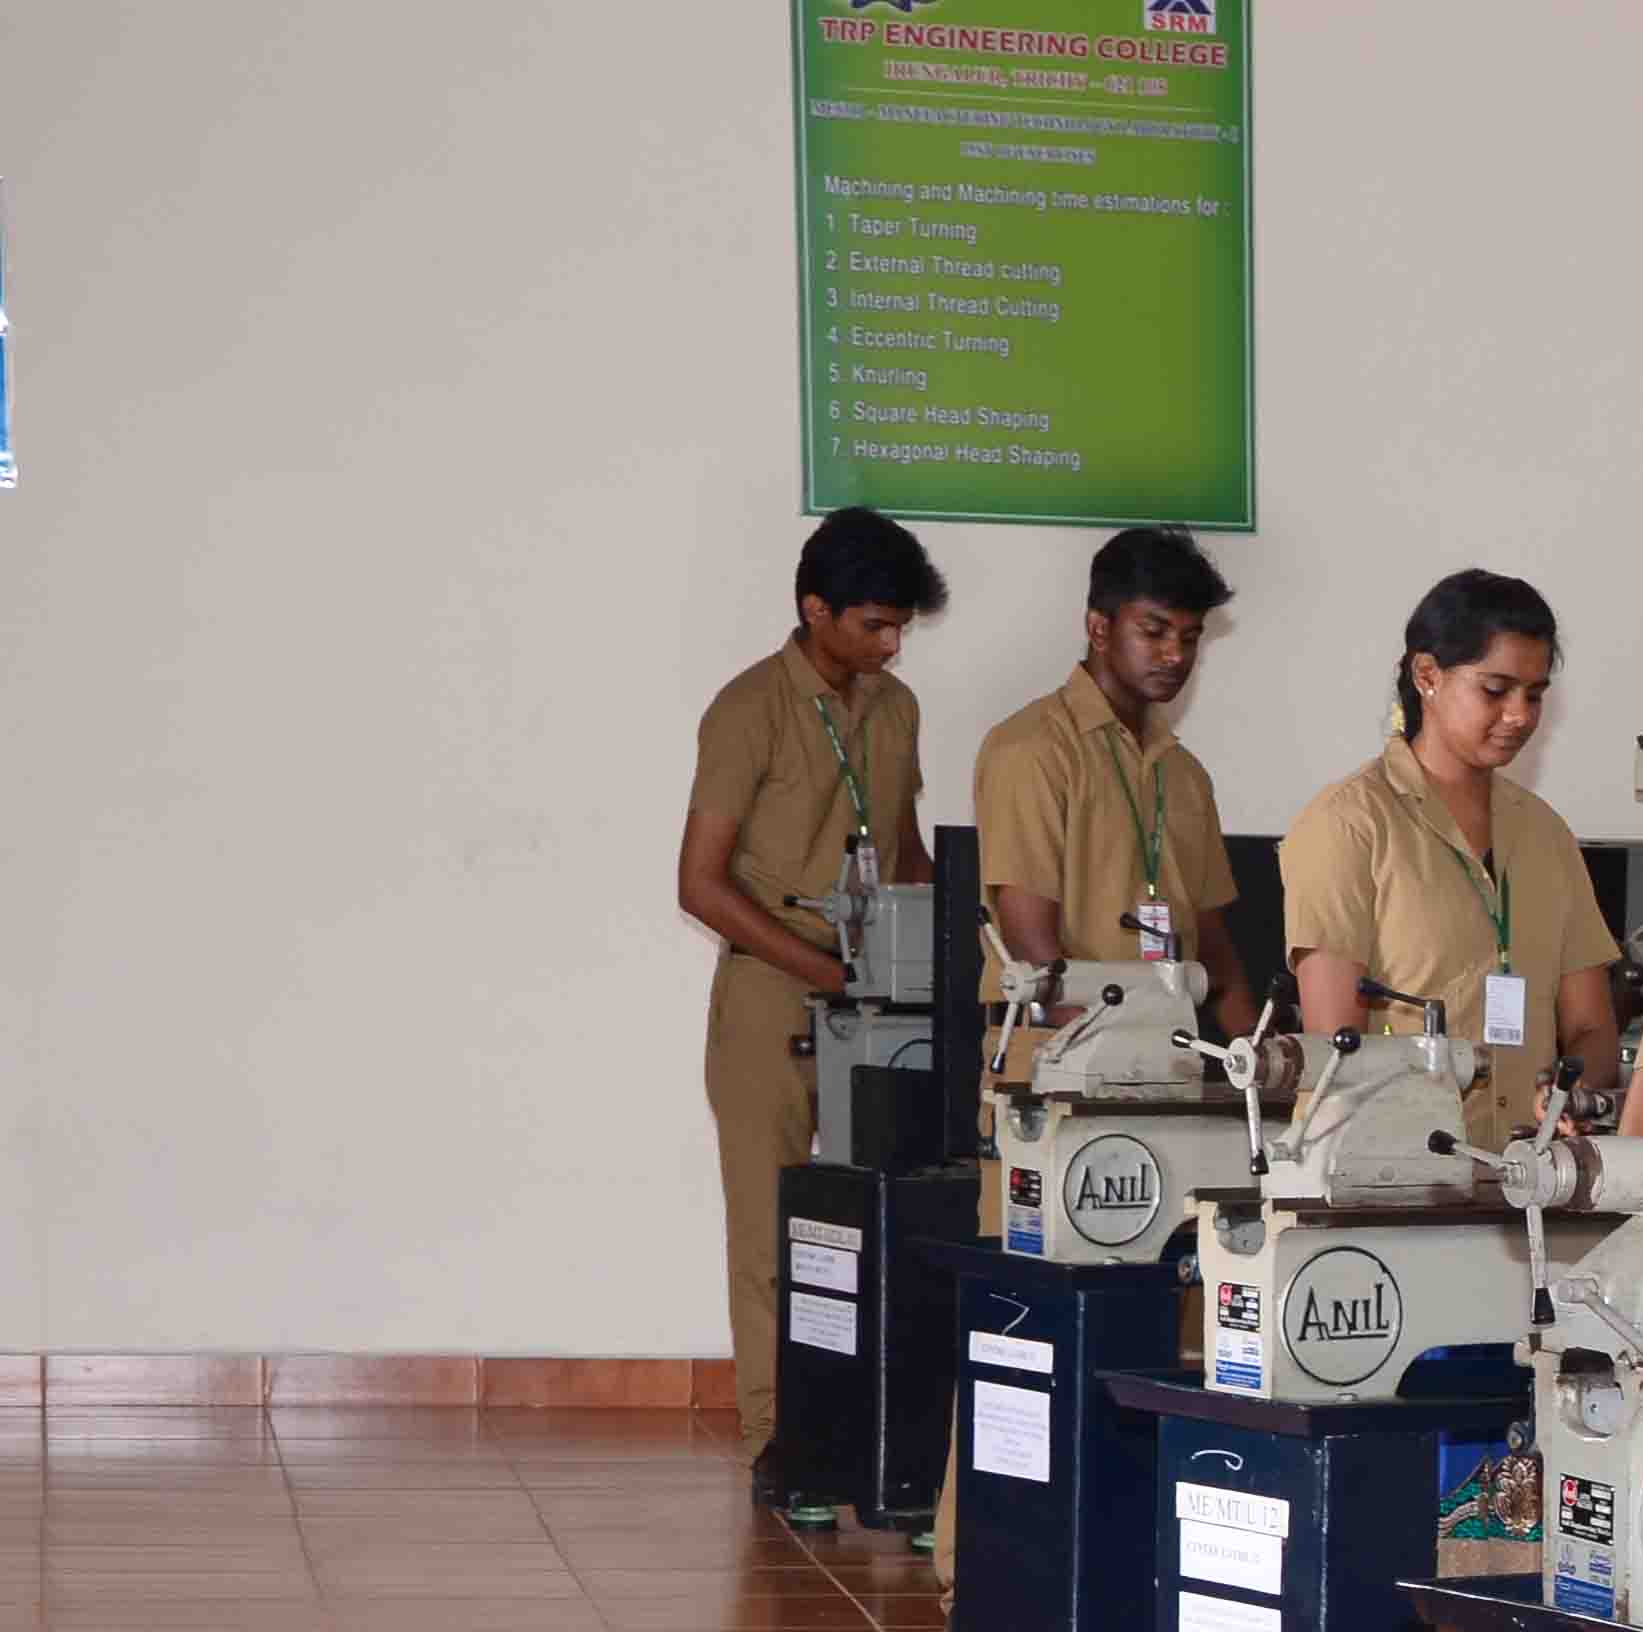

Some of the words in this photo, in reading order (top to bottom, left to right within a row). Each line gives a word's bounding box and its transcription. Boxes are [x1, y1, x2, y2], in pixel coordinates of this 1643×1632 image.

[1151, 14, 1208, 33] SRM
[820, 18, 876, 43] TRP
[885, 22, 1089, 58] ENGINEERING
[1097, 37, 1227, 67] COLLEGE
[823, 176, 913, 204] Machining
[919, 183, 952, 201] and
[959, 183, 1047, 212] Machining
[1052, 191, 1089, 210] time
[1094, 192, 1191, 215] estimations
[848, 213, 901, 237] Taper
[911, 217, 977, 247] Turning
[849, 251, 925, 274] External
[932, 256, 993, 278] Thread
[850, 289, 920, 312] Internal
[928, 292, 992, 315] Thread
[852, 326, 937, 349] Eccentric
[943, 331, 1009, 357] Turning
[853, 364, 928, 391] Knurling
[854, 400, 918, 424] Square
[924, 405, 971, 425] Head
[977, 406, 1051, 432] Shaping
[853, 440, 949, 465] Hexagonal
[955, 445, 1002, 465] Head
[1008, 445, 1081, 472] Shaping
[1073, 1163, 1152, 1211] ANIL
[1297, 1283, 1390, 1341] ANIL
